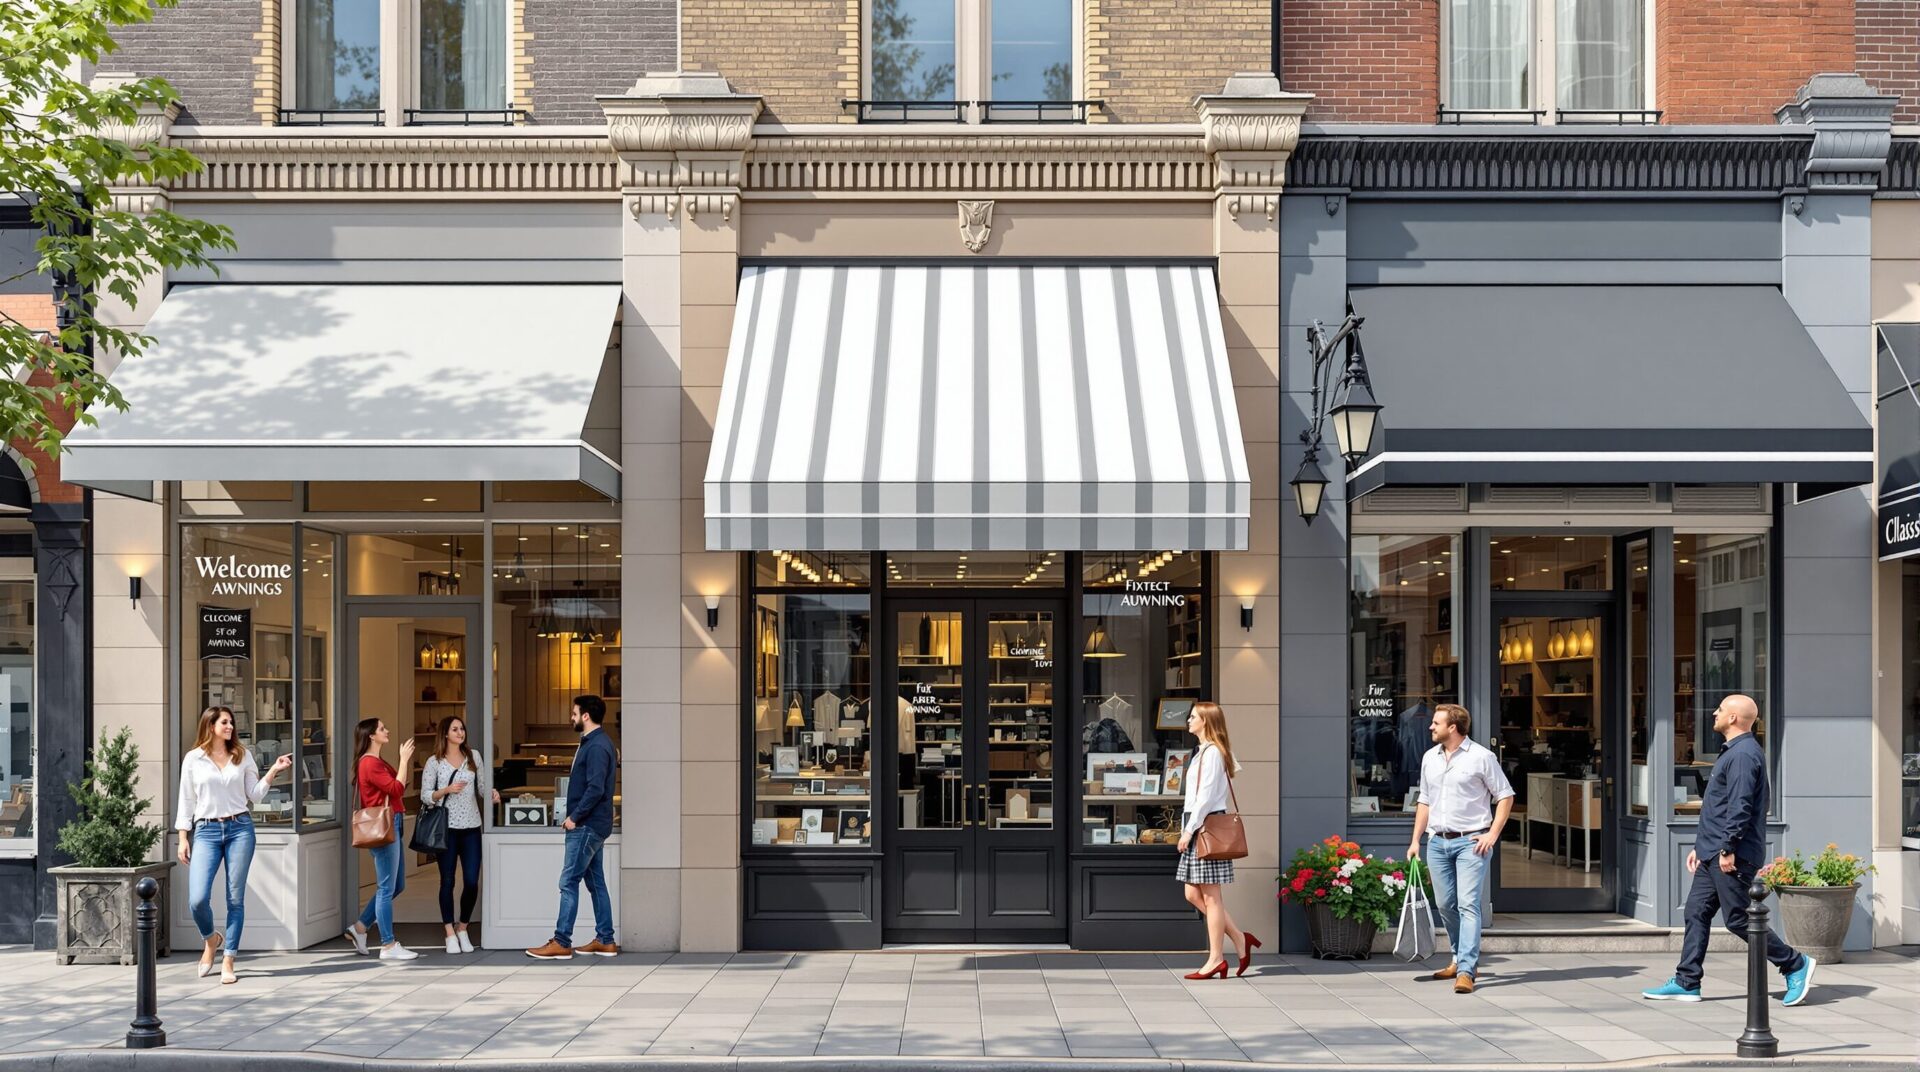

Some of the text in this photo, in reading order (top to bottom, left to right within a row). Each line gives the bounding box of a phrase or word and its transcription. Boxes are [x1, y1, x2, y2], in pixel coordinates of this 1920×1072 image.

[195, 554, 292, 579] Welcome
[211, 582, 283, 596] AWNINGS
[1125, 579, 1170, 592] FIXTECT
[1120, 594, 1185, 607] AUWNING
